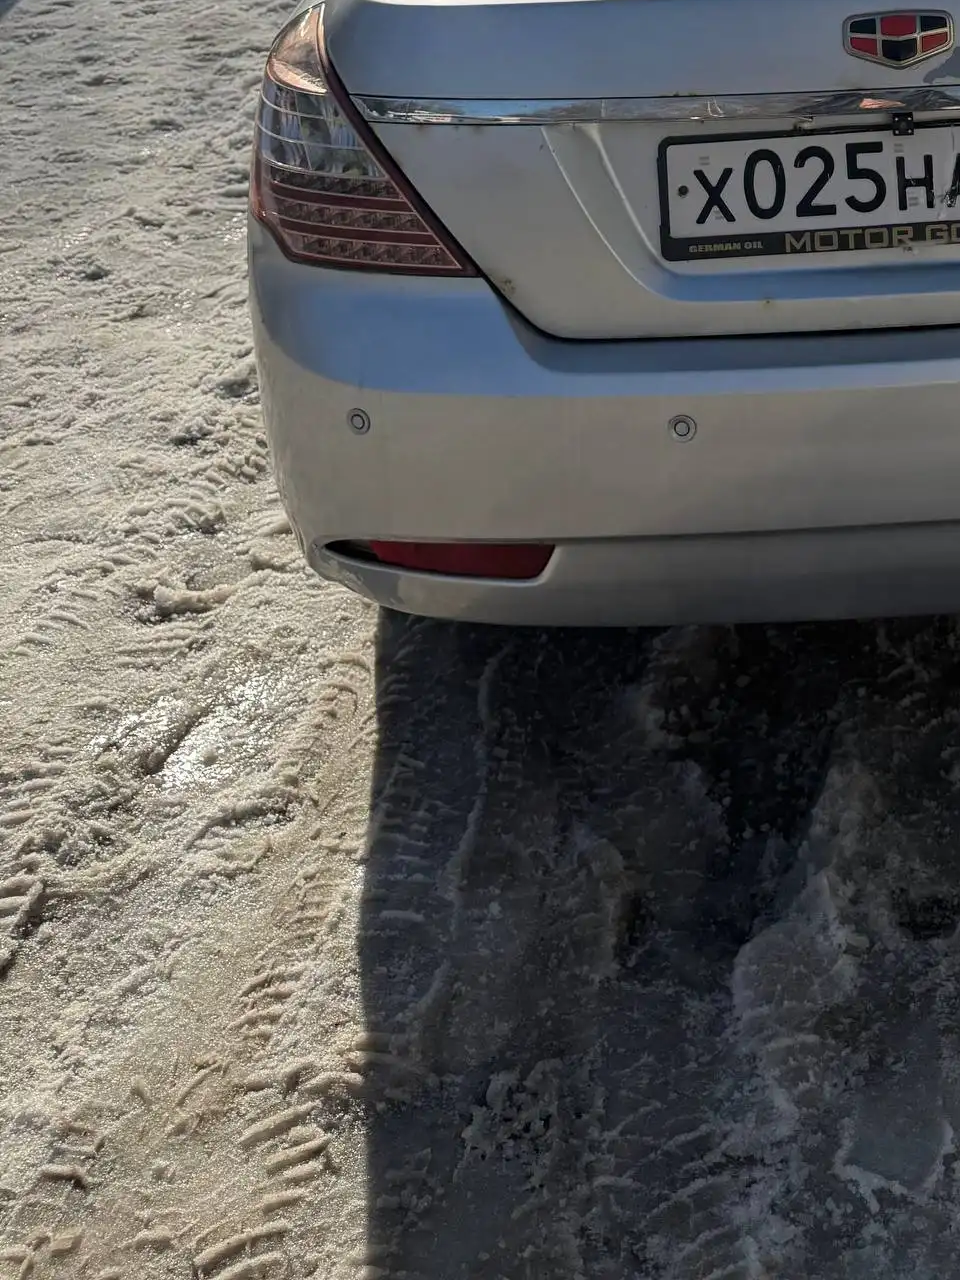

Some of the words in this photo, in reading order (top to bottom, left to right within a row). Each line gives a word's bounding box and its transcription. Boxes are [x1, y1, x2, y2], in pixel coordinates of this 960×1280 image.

[689, 242, 741, 253] GERMAN
[744, 240, 763, 250] OIL
[785, 226, 913, 253] MOTOR
